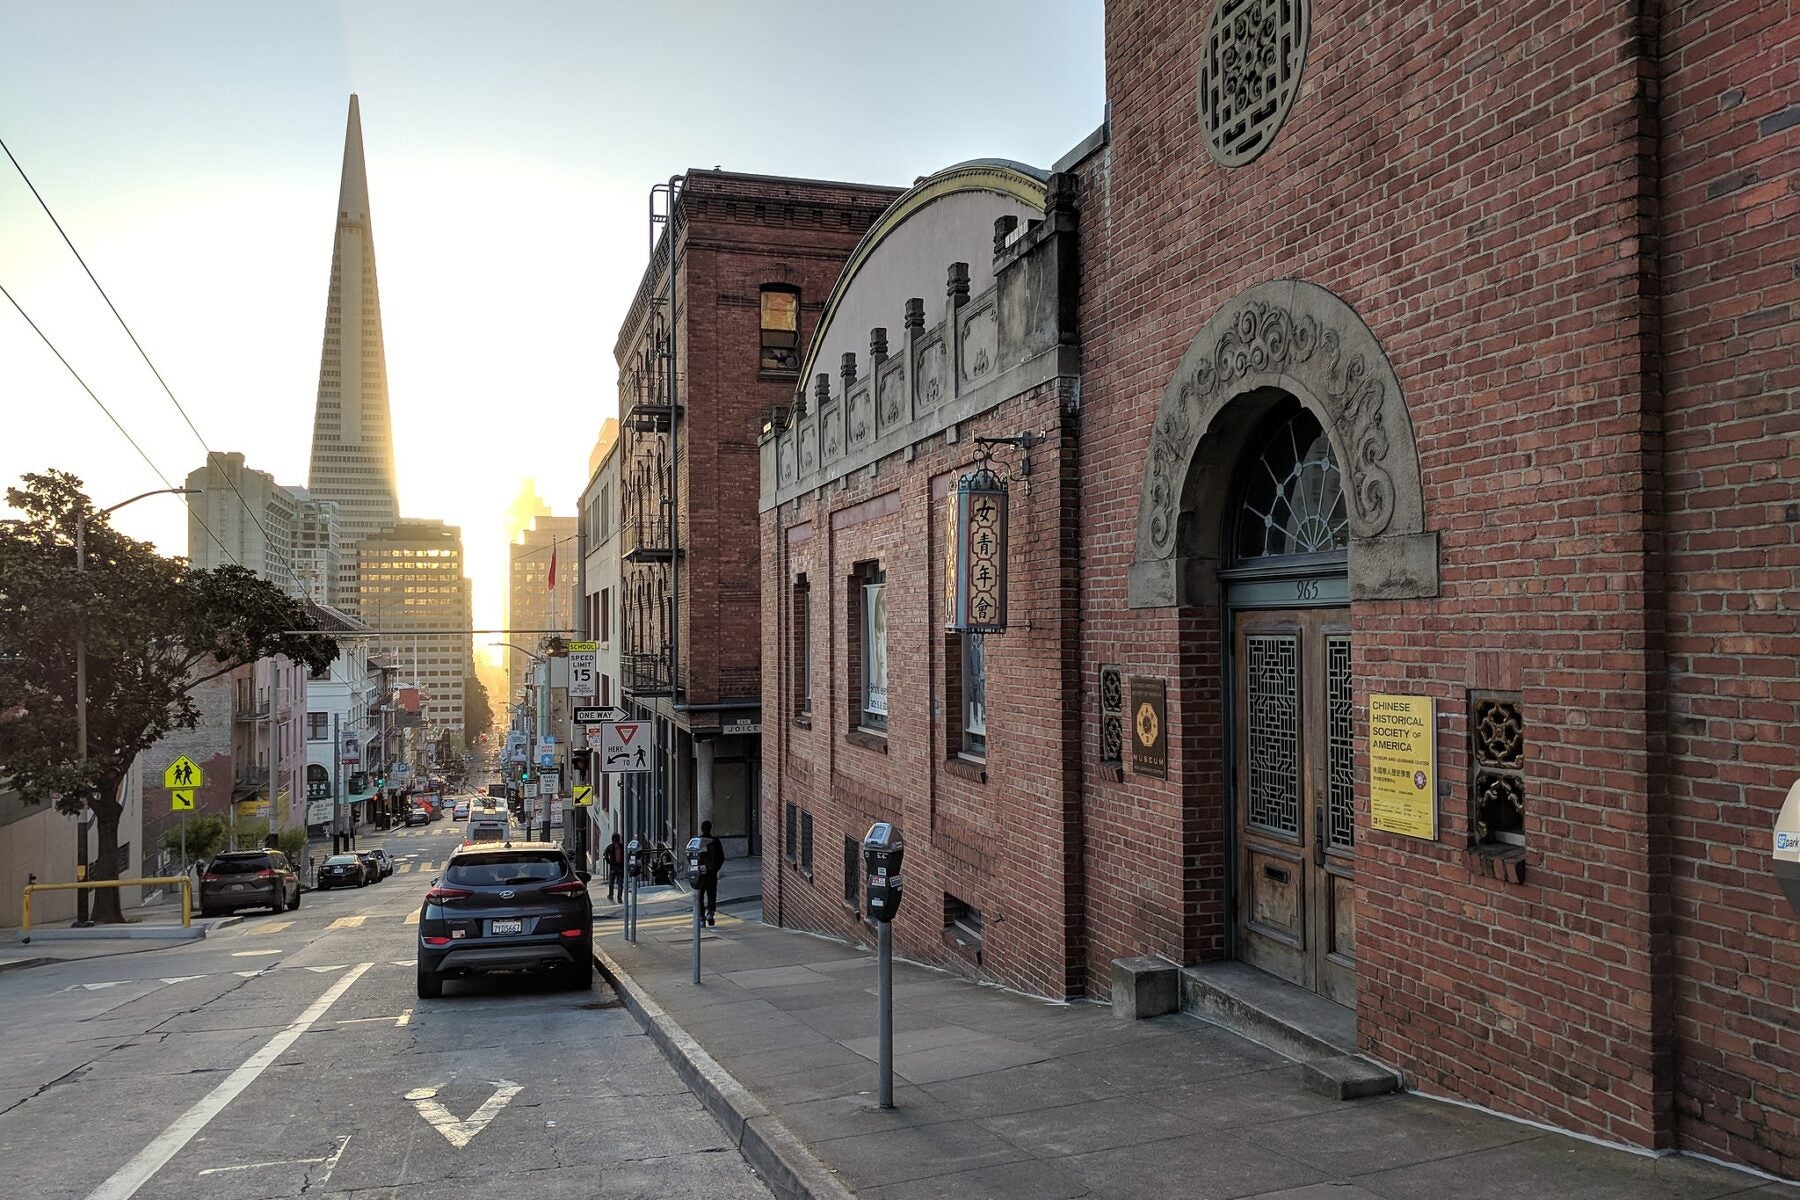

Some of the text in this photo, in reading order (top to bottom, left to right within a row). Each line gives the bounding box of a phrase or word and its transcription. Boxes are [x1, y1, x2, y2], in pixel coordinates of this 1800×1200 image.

[975, 499, 996, 620] 女青年會
[1297, 580, 1319, 600] 965
[573, 669, 591, 682] 15
[1372, 701, 1411, 712] CHINESE
[597, 711, 613, 719] WAY
[1372, 714, 1424, 727] HISTORICAL
[1372, 726, 1422, 739] SOCIETY OF
[607, 745, 624, 753] HERE
[1372, 740, 1413, 752] AMERICA
[1133, 754, 1164, 766] MUSEUM
